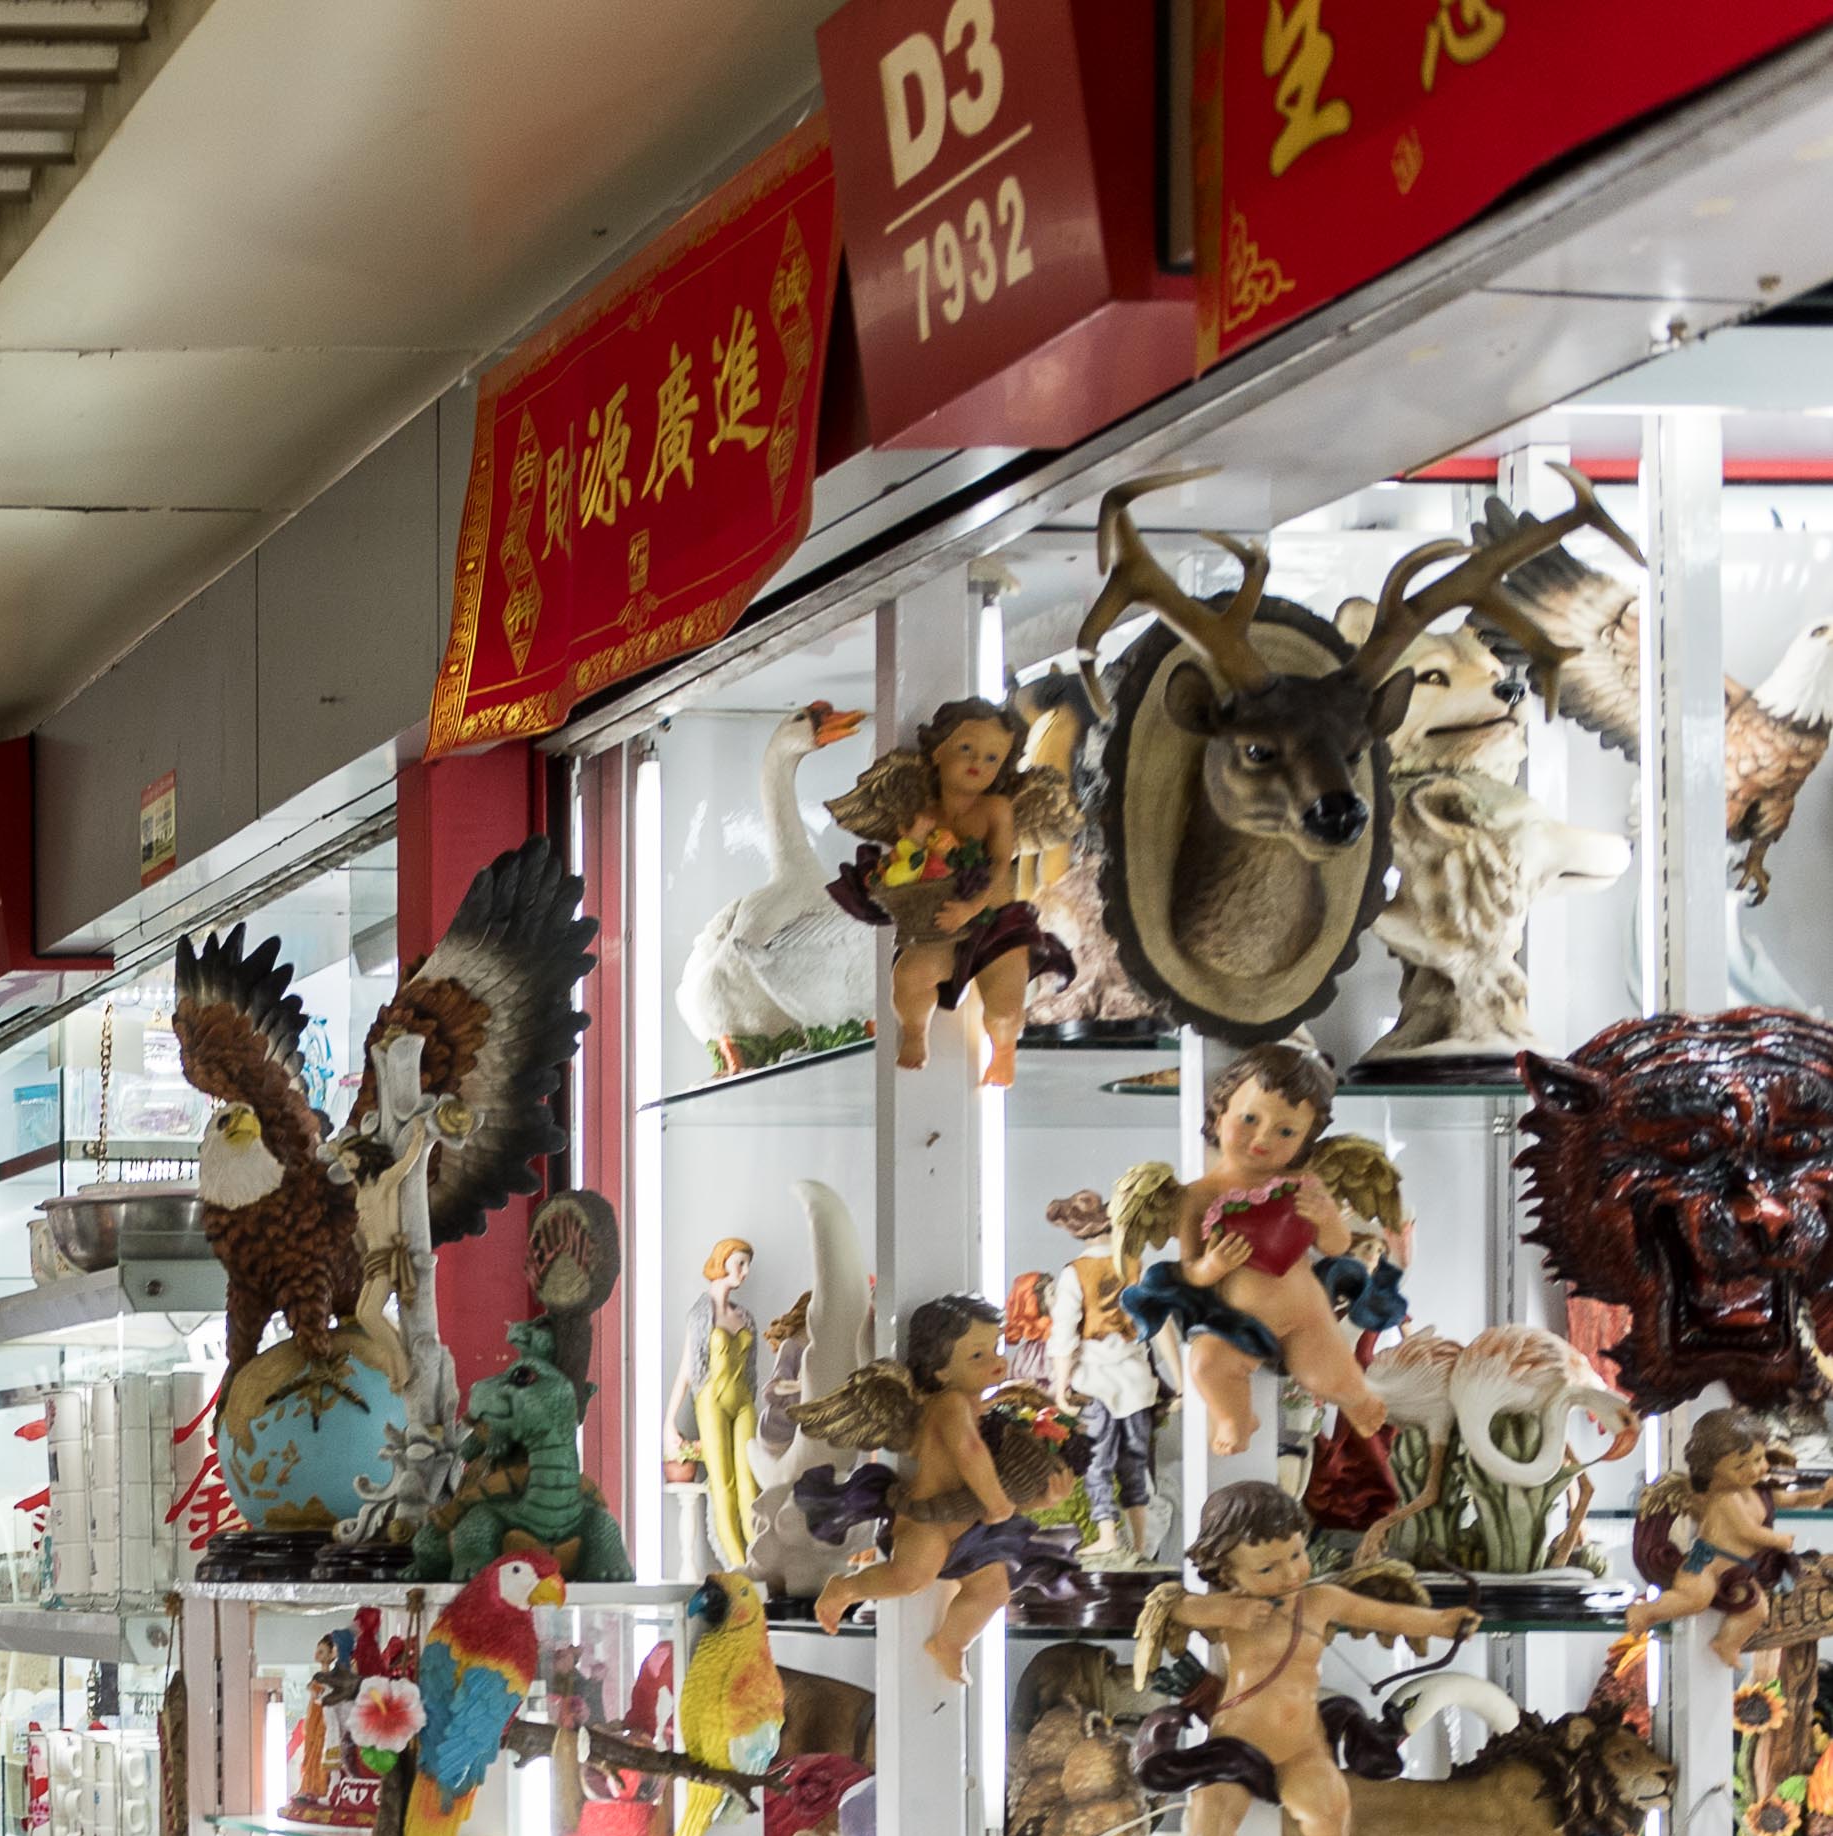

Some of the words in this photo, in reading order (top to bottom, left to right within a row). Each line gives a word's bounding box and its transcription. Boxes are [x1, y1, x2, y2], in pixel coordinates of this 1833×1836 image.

[879, 0, 1005, 190] D3
[902, 174, 1034, 344] 7932
[540, 304, 770, 561] 財源廣進
